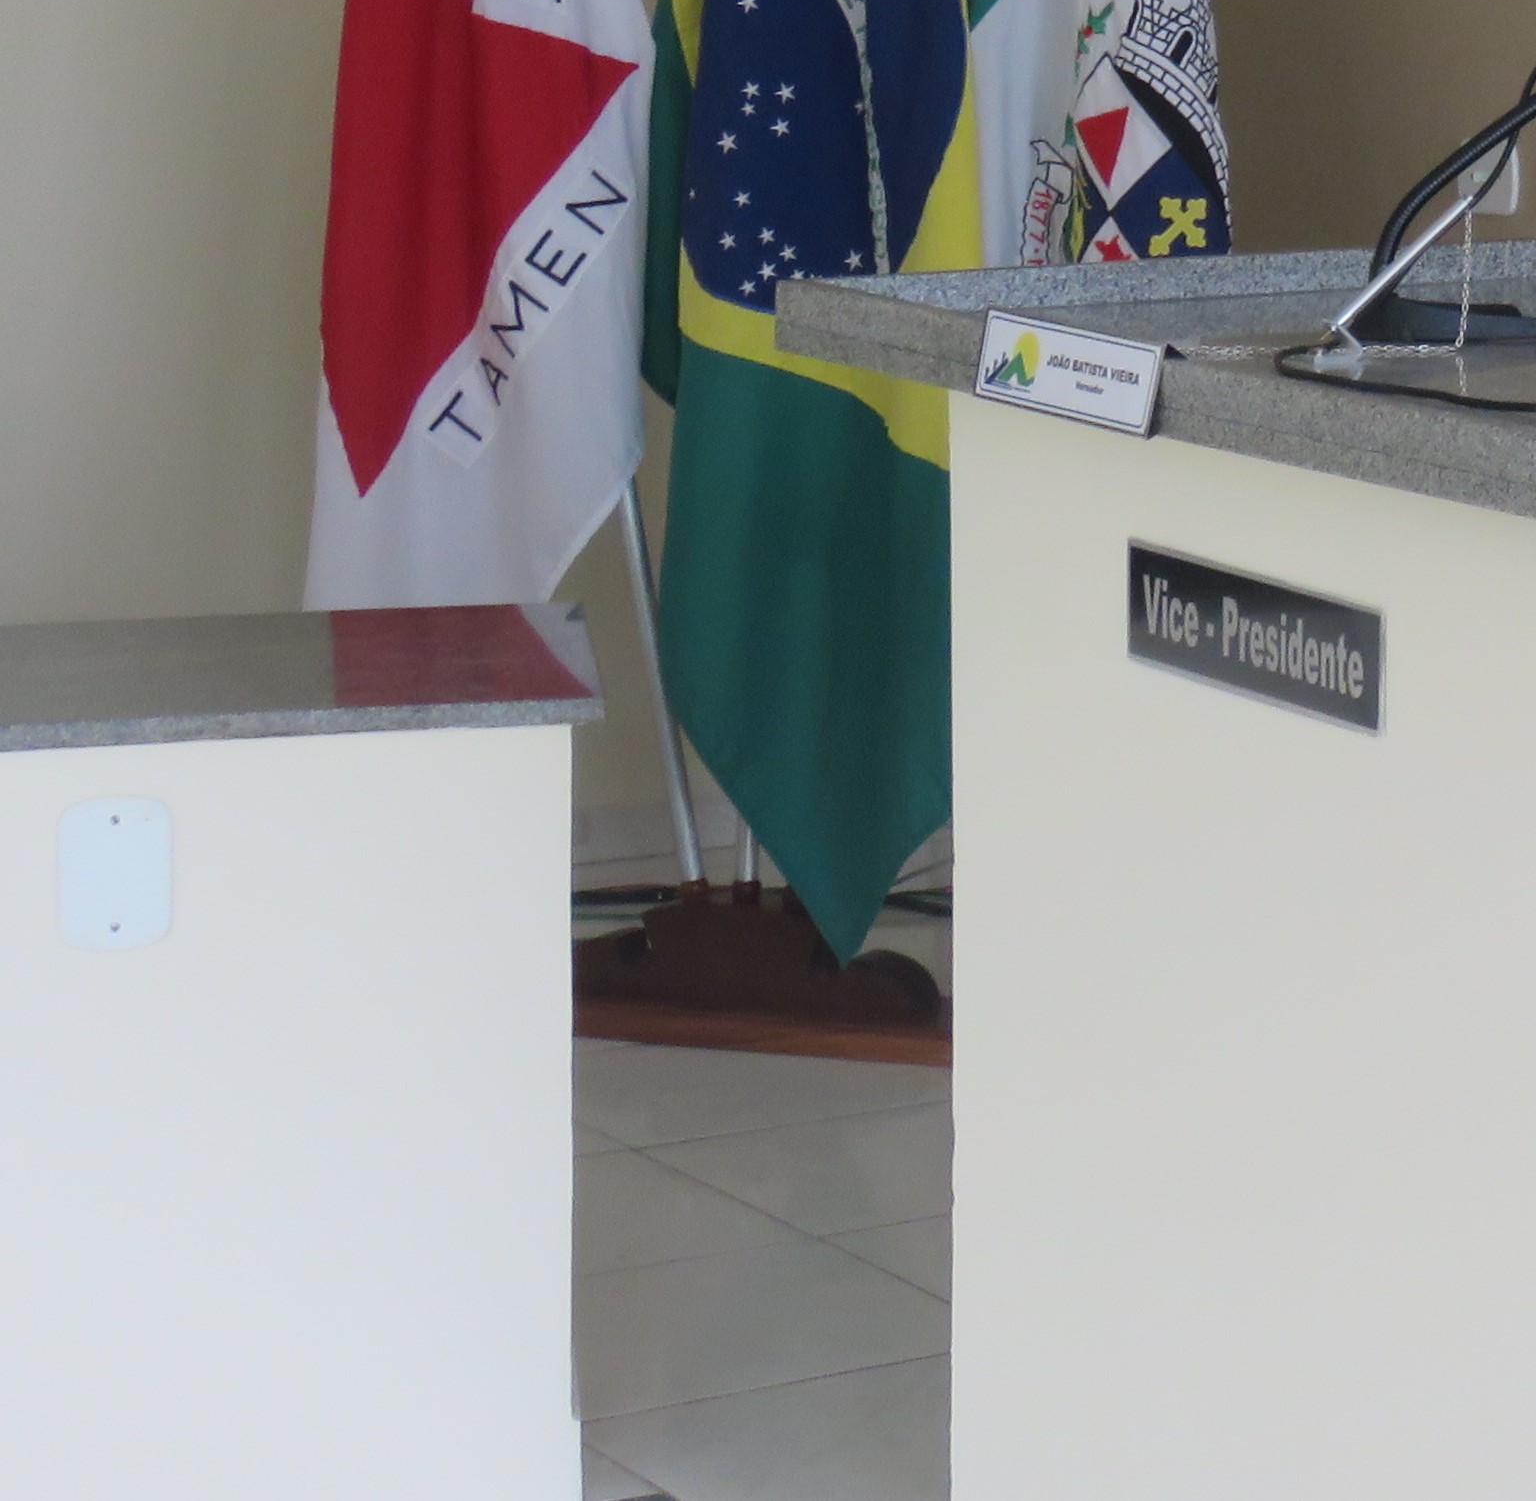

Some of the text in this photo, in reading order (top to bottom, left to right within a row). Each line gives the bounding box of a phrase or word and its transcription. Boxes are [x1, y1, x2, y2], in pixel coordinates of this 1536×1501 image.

[428, 169, 629, 443] TAMEN
[1072, 358, 1108, 379] BATISTA
[1110, 367, 1140, 386] VIEIRA
[1142, 573, 1200, 648] Vice
[1221, 595, 1365, 699] Presidente
